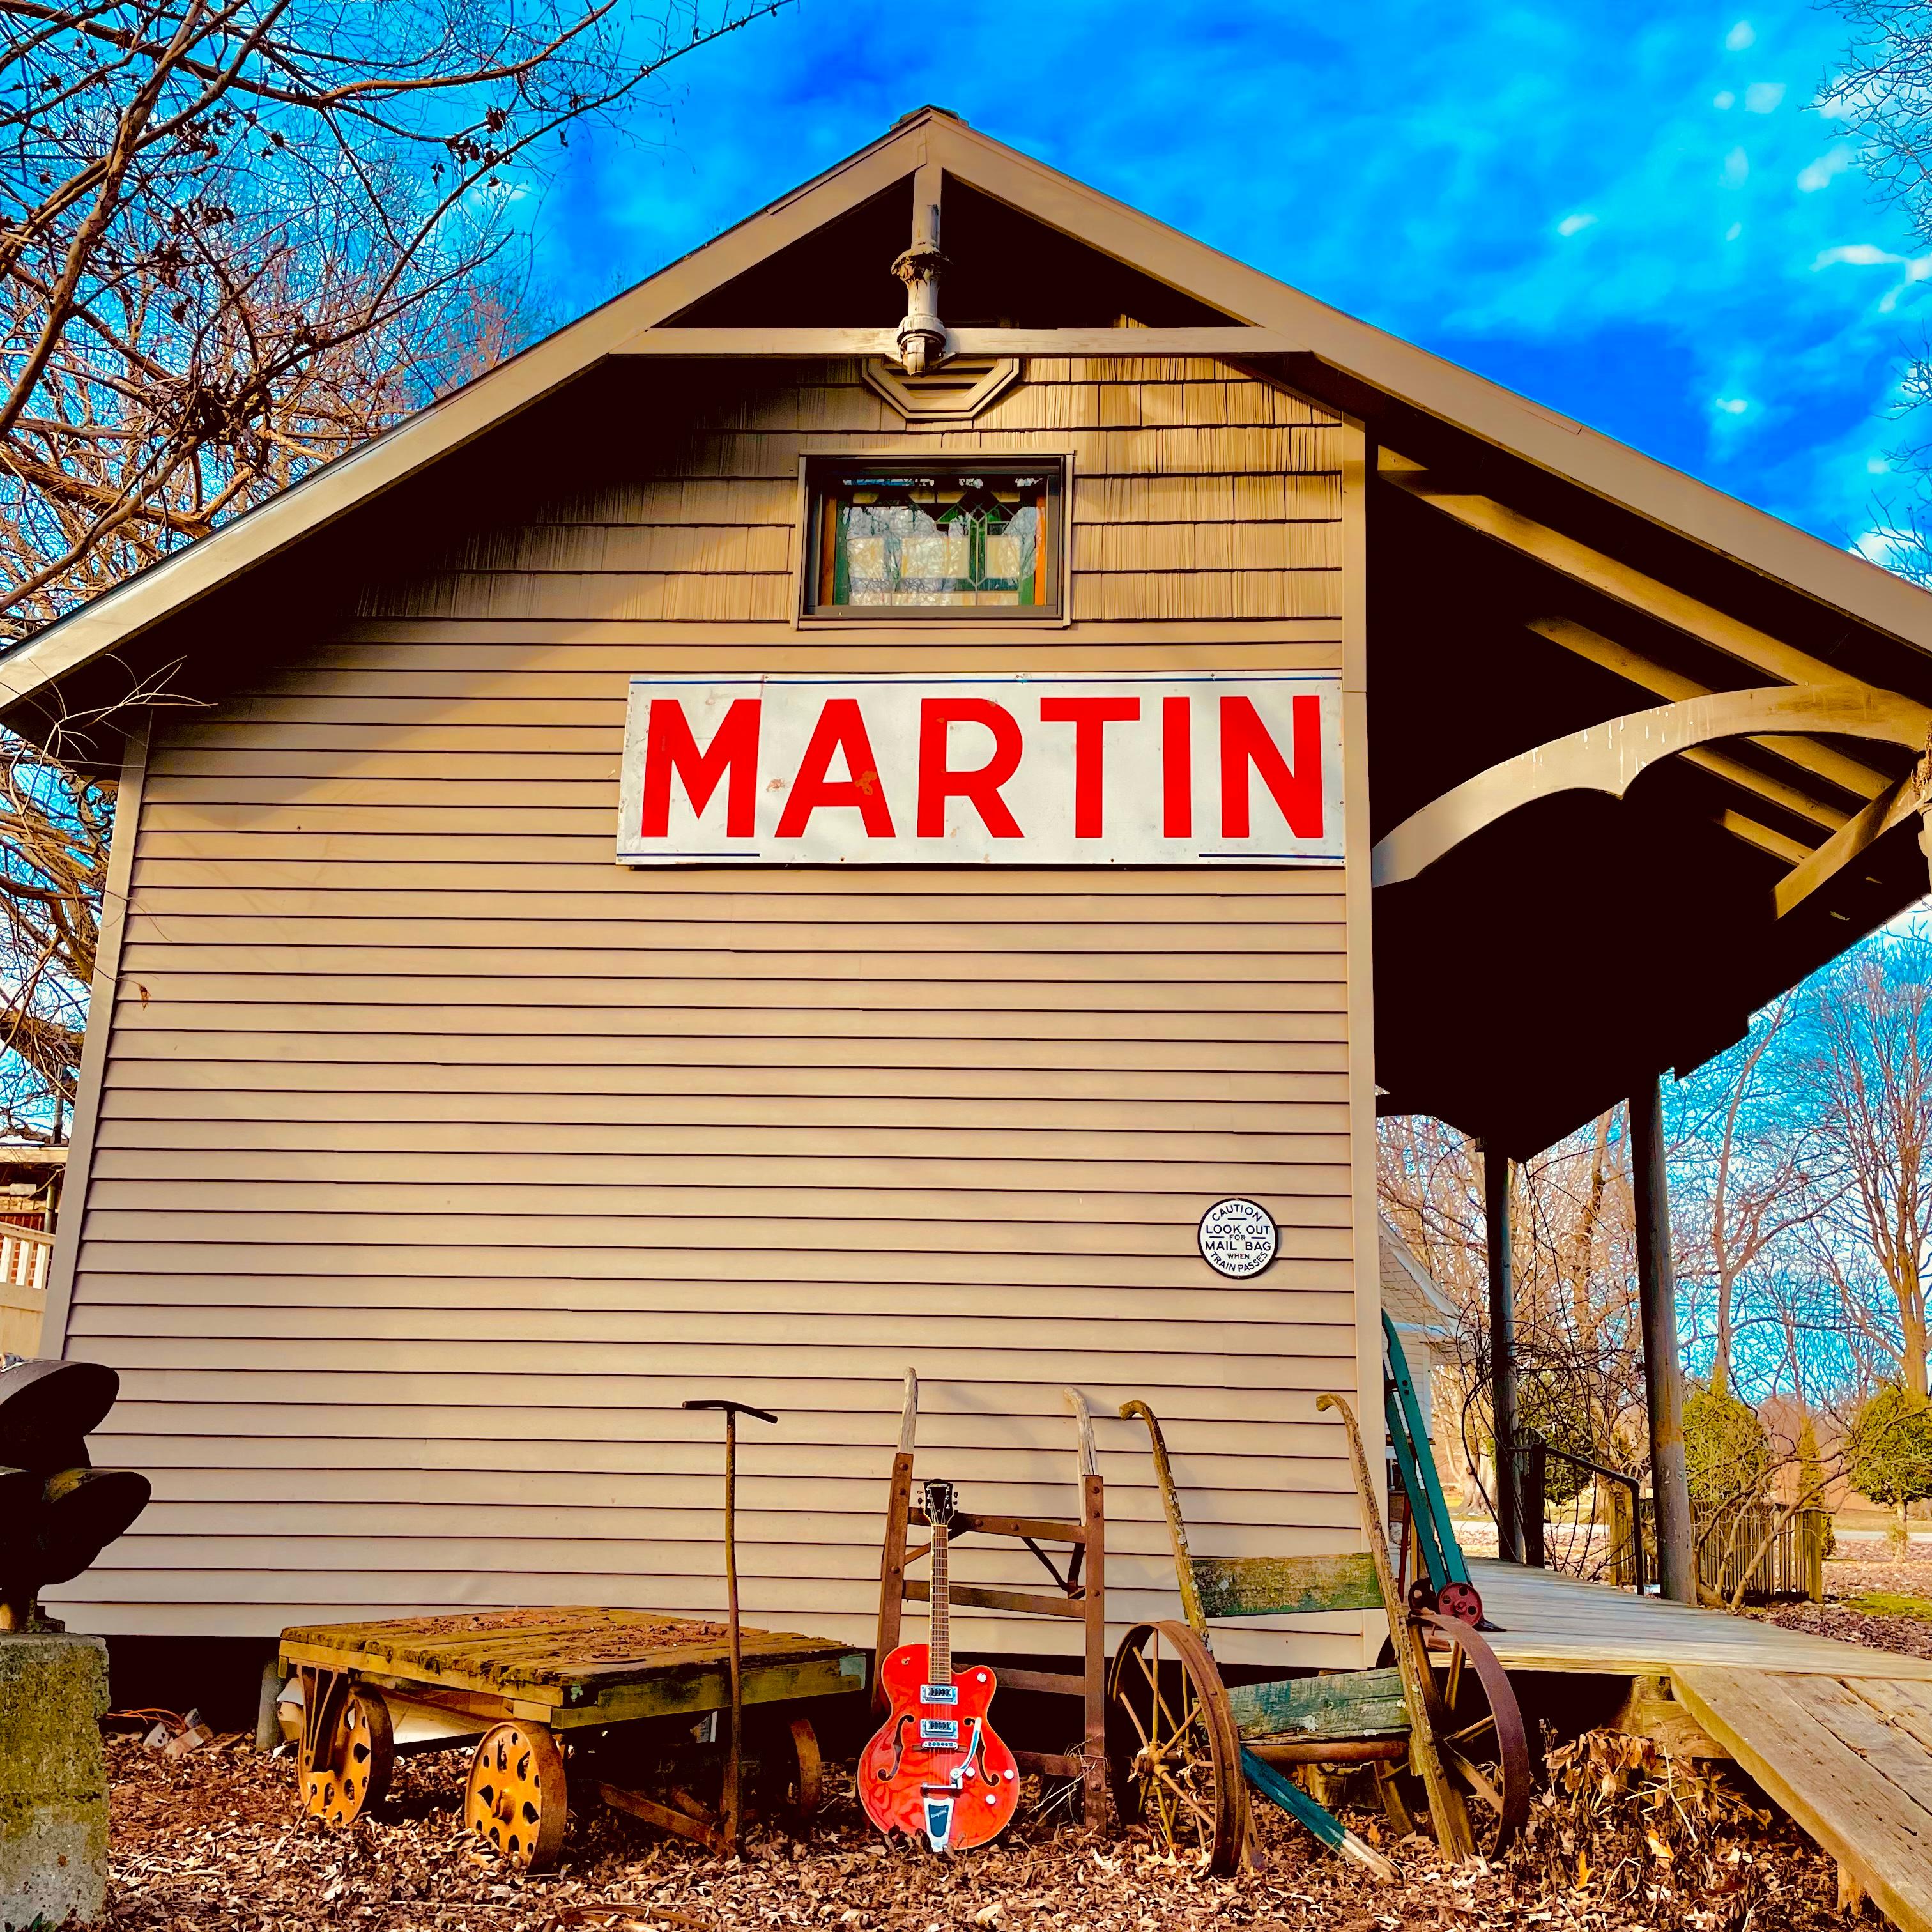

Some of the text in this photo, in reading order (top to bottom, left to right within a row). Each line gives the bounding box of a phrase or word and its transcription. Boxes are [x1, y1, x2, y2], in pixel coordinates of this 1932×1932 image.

[641, 696, 1324, 839] MARTIN
[1212, 1204, 1262, 1222] CAUTION
[1206, 1225, 1270, 1234] LOOK OUT
[1206, 1241, 1271, 1251] MAIL BAG
[1210, 1251, 1268, 1272] TRAIN PASSES
